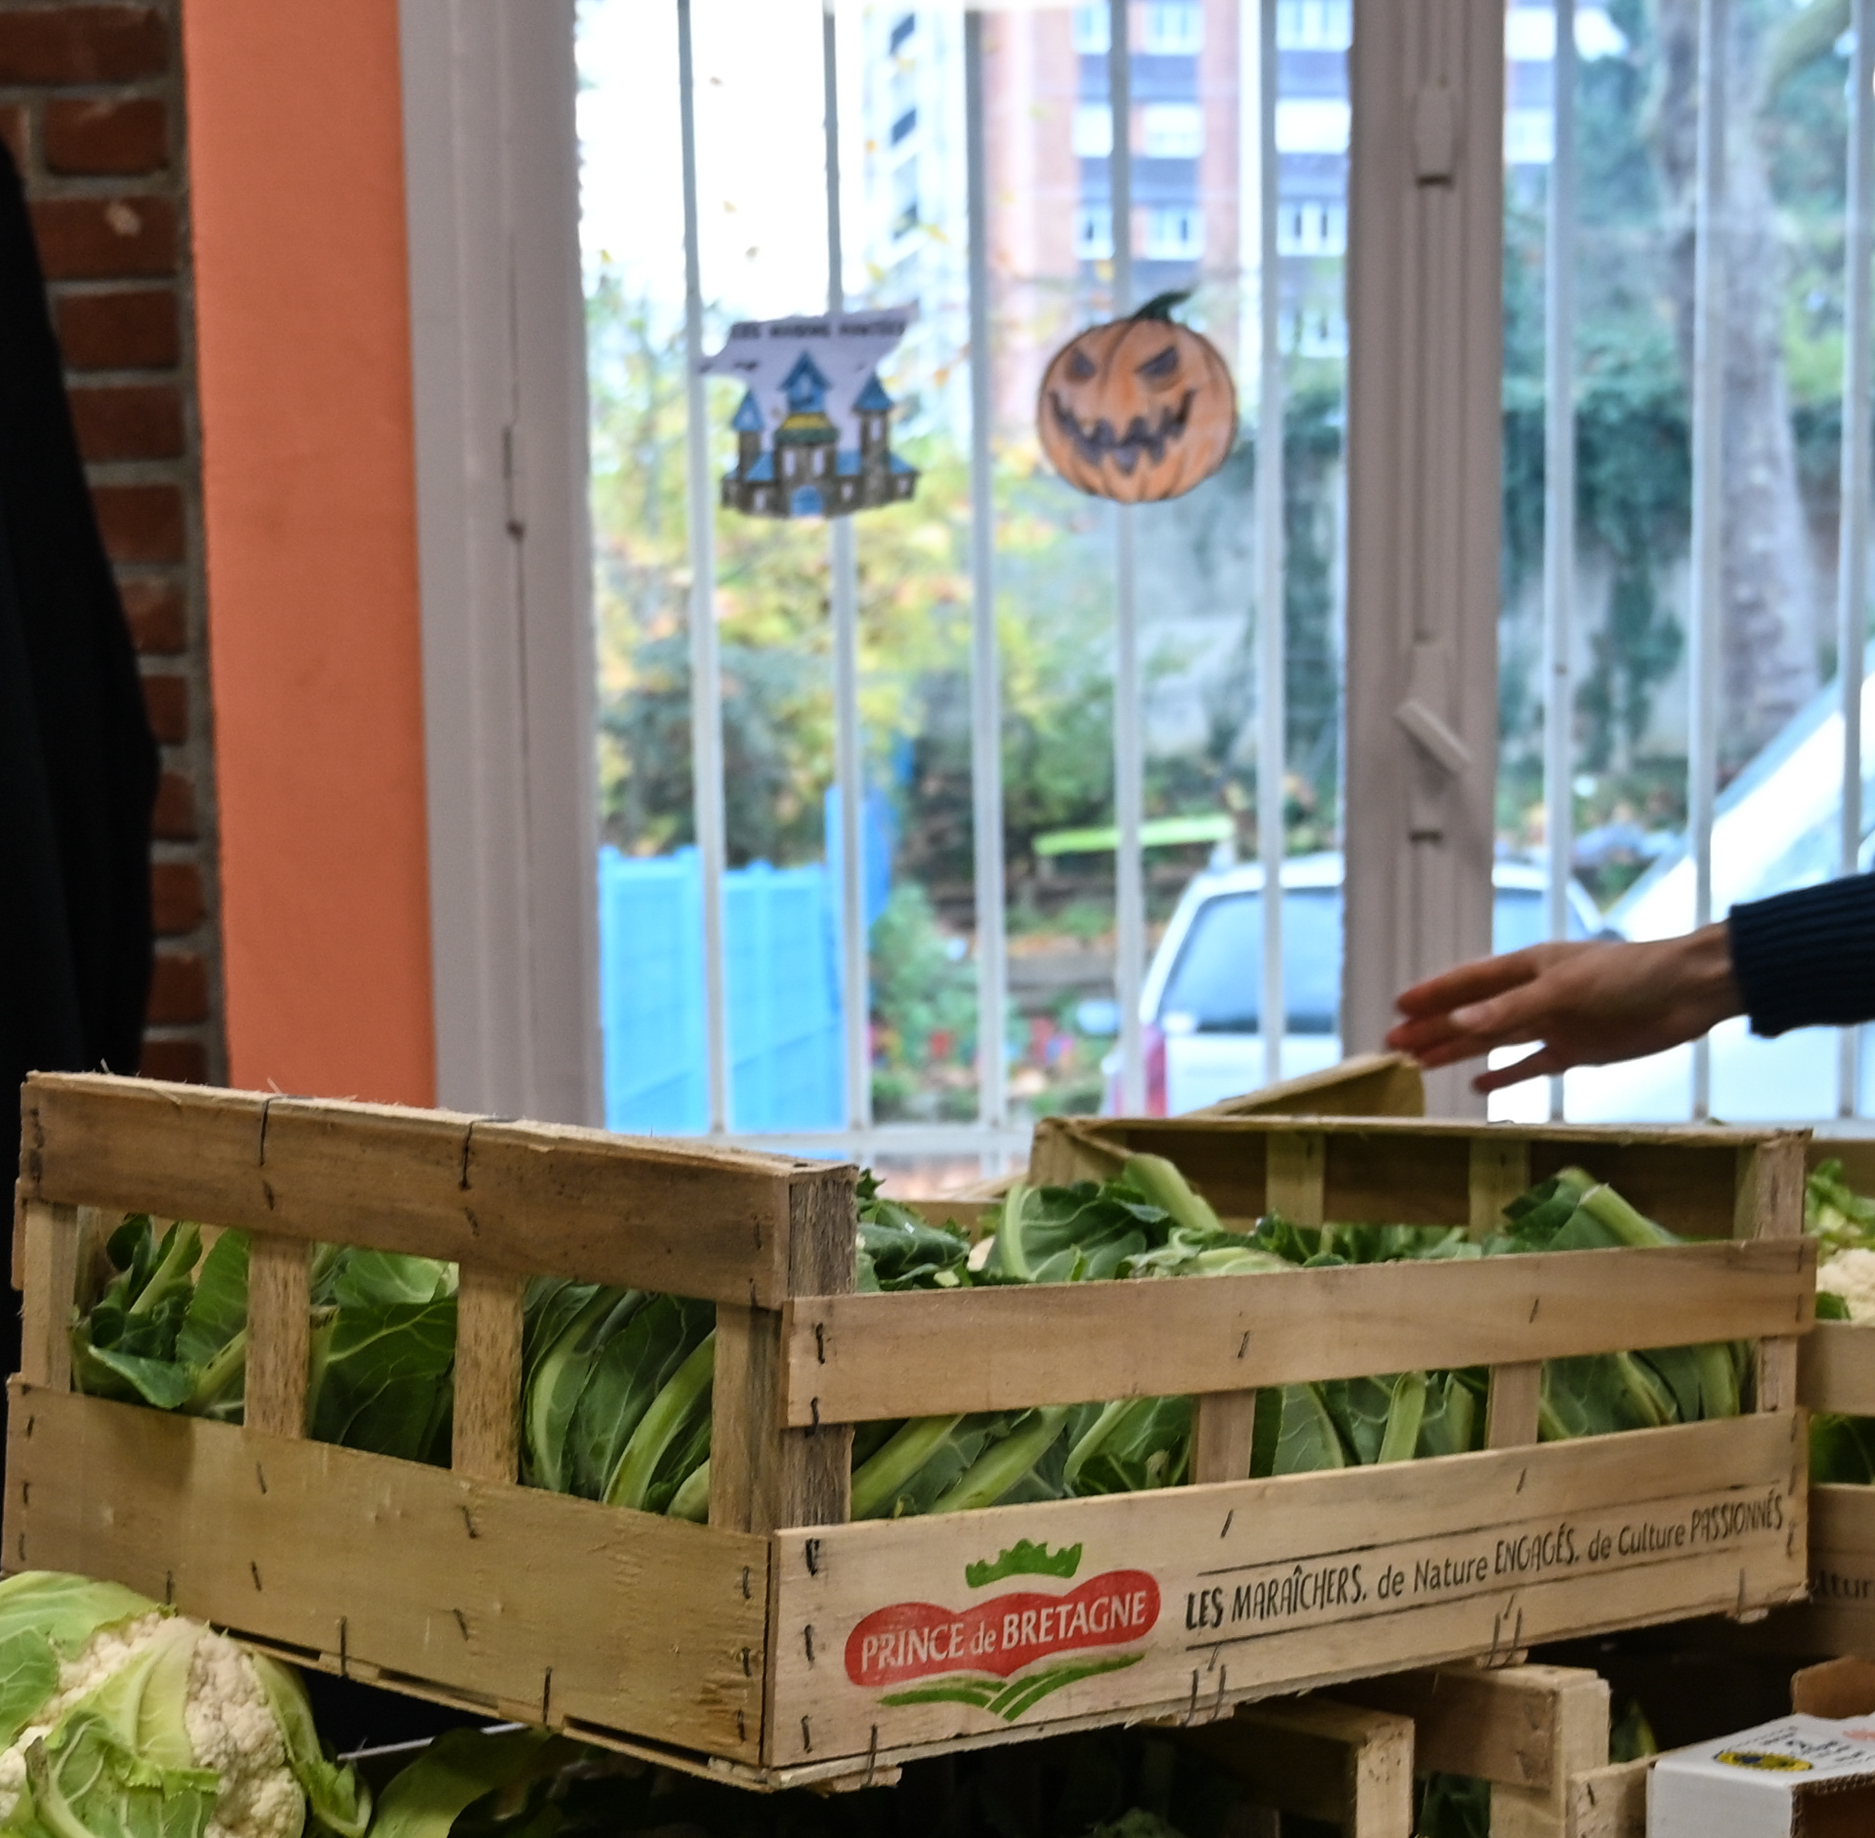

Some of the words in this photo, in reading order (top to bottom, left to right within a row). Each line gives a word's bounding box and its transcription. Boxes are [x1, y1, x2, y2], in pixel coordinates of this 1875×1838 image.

[1185, 1586, 1223, 1631] LES
[1377, 1564, 1405, 1600] de
[1413, 1556, 1488, 1593] Nature
[1588, 1529, 1612, 1562] de
[1618, 1522, 1685, 1556] Culture
[1690, 1489, 1784, 1543] PASSIONNÉS
[861, 1622, 965, 1673] PRINCE
[970, 1621, 996, 1655] de
[1001, 1590, 1147, 1650] BRETAGNE
